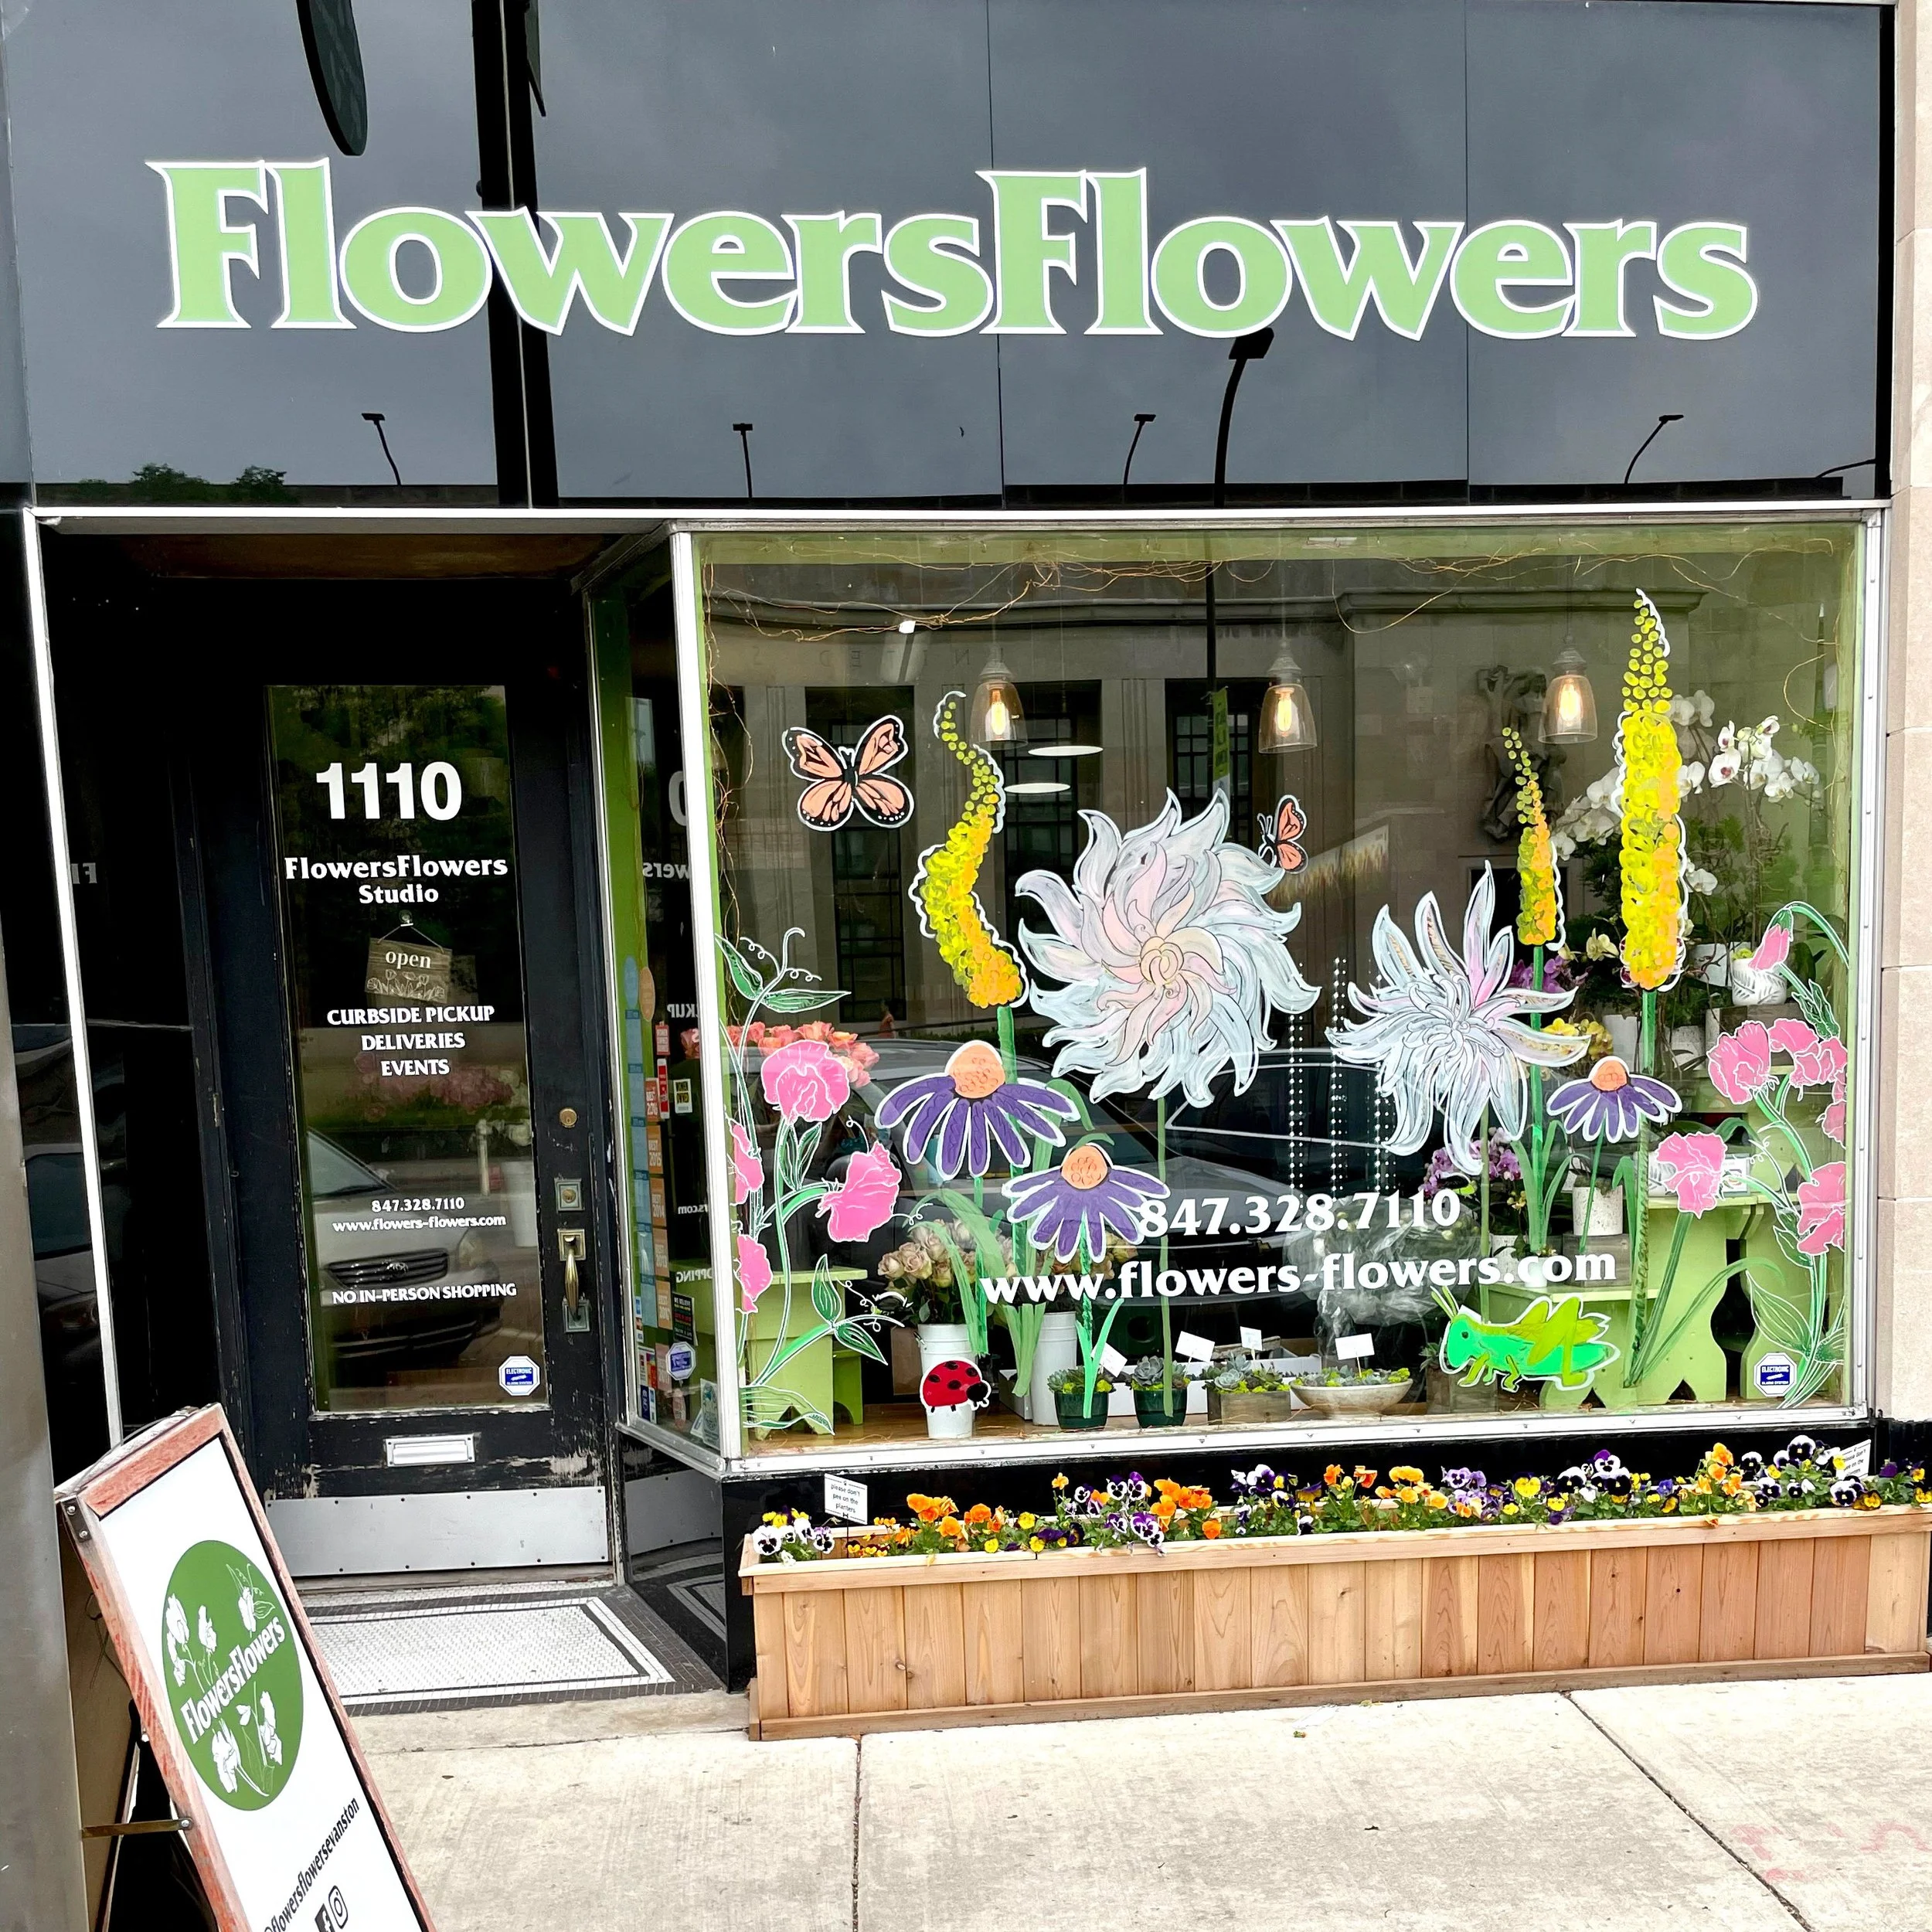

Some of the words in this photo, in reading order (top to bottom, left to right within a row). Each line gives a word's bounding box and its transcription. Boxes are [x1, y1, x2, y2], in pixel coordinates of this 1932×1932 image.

[145, 158, 1760, 341] FlowersFlowers
[316, 761, 462, 821] 1110
[284, 855, 509, 879] FlowersFlowers
[359, 883, 439, 904] Studio
[385, 948, 432, 970] open
[327, 1007, 422, 1026] CURBSIDE
[426, 1005, 495, 1022] PICKUP
[361, 1032, 466, 1051] DELIVERIES
[380, 1059, 451, 1077] EVENTS
[372, 1197, 464, 1213] 847.328.7110
[1138, 1187, 1461, 1237] 847.328.7110
[332, 1214, 506, 1232] www.flowers-flowers.com
[979, 1251, 1617, 1304] www.flowers-flowers.com
[332, 1291, 356, 1304] NO
[359, 1286, 440, 1303] IN-PERSON
[442, 1283, 517, 1299] SHOPPING
[180, 1616, 285, 1745] FlowersFlowers
